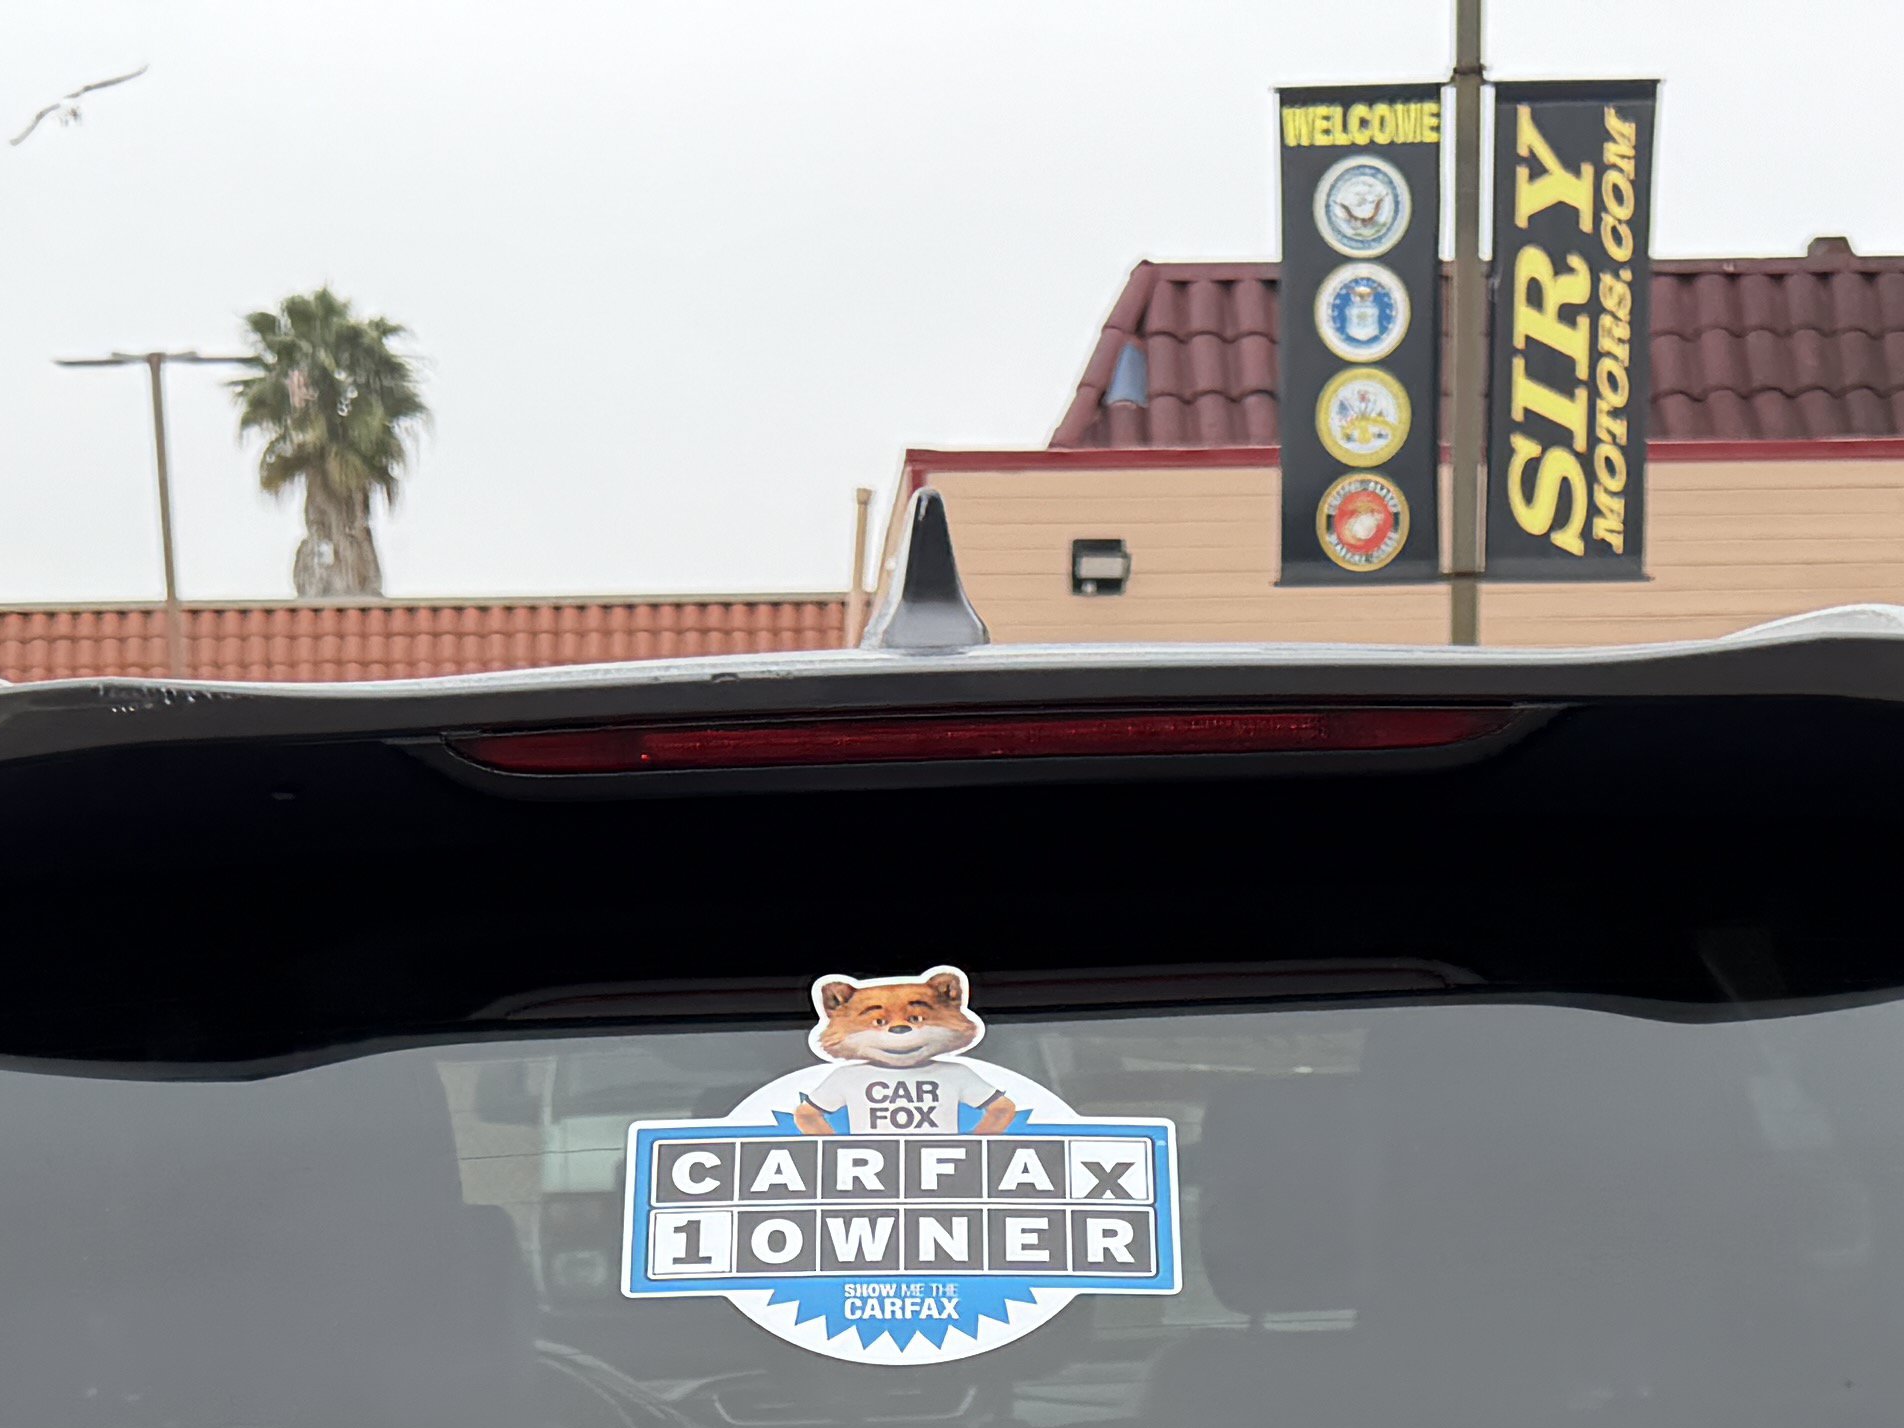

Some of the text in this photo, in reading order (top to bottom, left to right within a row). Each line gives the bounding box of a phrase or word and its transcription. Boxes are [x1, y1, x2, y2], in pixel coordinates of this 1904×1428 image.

[1282, 103, 1441, 146] WELCOME
[1507, 105, 1595, 557] SIRY
[1592, 106, 1637, 554] MOTORS.COM
[865, 1080, 940, 1104] CAR
[869, 1106, 939, 1129] FOX
[671, 1147, 1135, 1201] CARFAX
[672, 1215, 1135, 1266] 1 OWNER
[844, 1283, 959, 1298] SHOW ME THE
[844, 1297, 960, 1320] CARFAX
